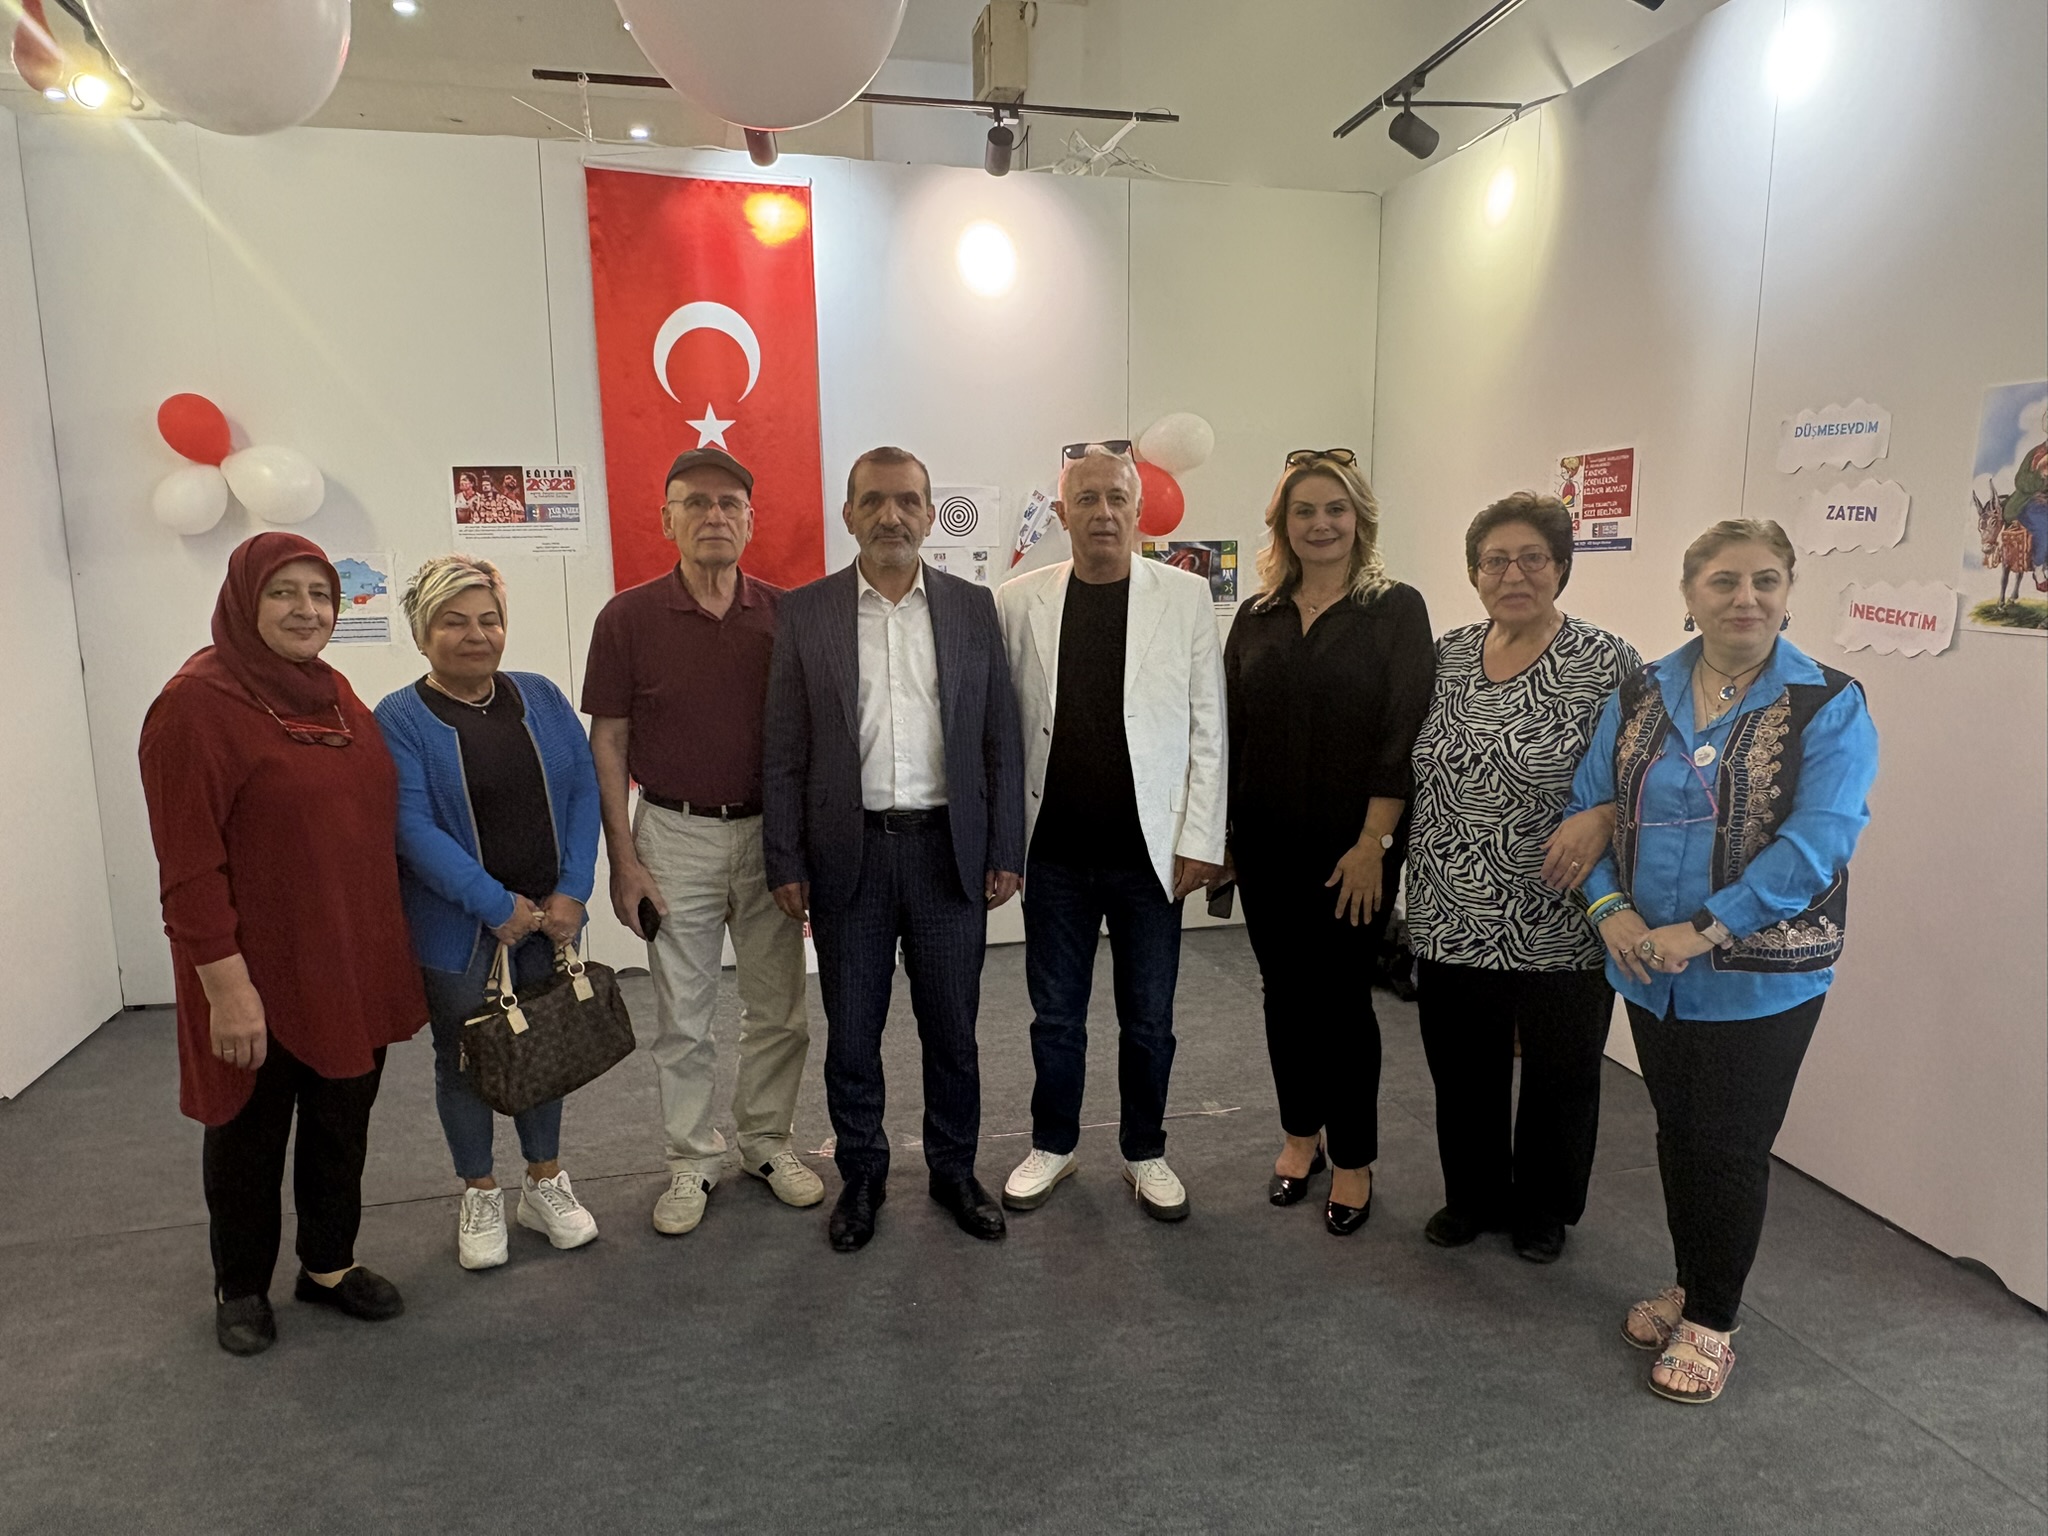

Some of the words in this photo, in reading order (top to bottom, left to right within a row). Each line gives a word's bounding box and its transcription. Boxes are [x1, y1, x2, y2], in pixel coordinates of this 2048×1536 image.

[1794, 420, 1879, 439] DÜŞMESEYDİM
[526, 478, 575, 491] 2023
[1826, 505, 1878, 522] ZATEN
[1849, 600, 1937, 632] İNECEKTİM
